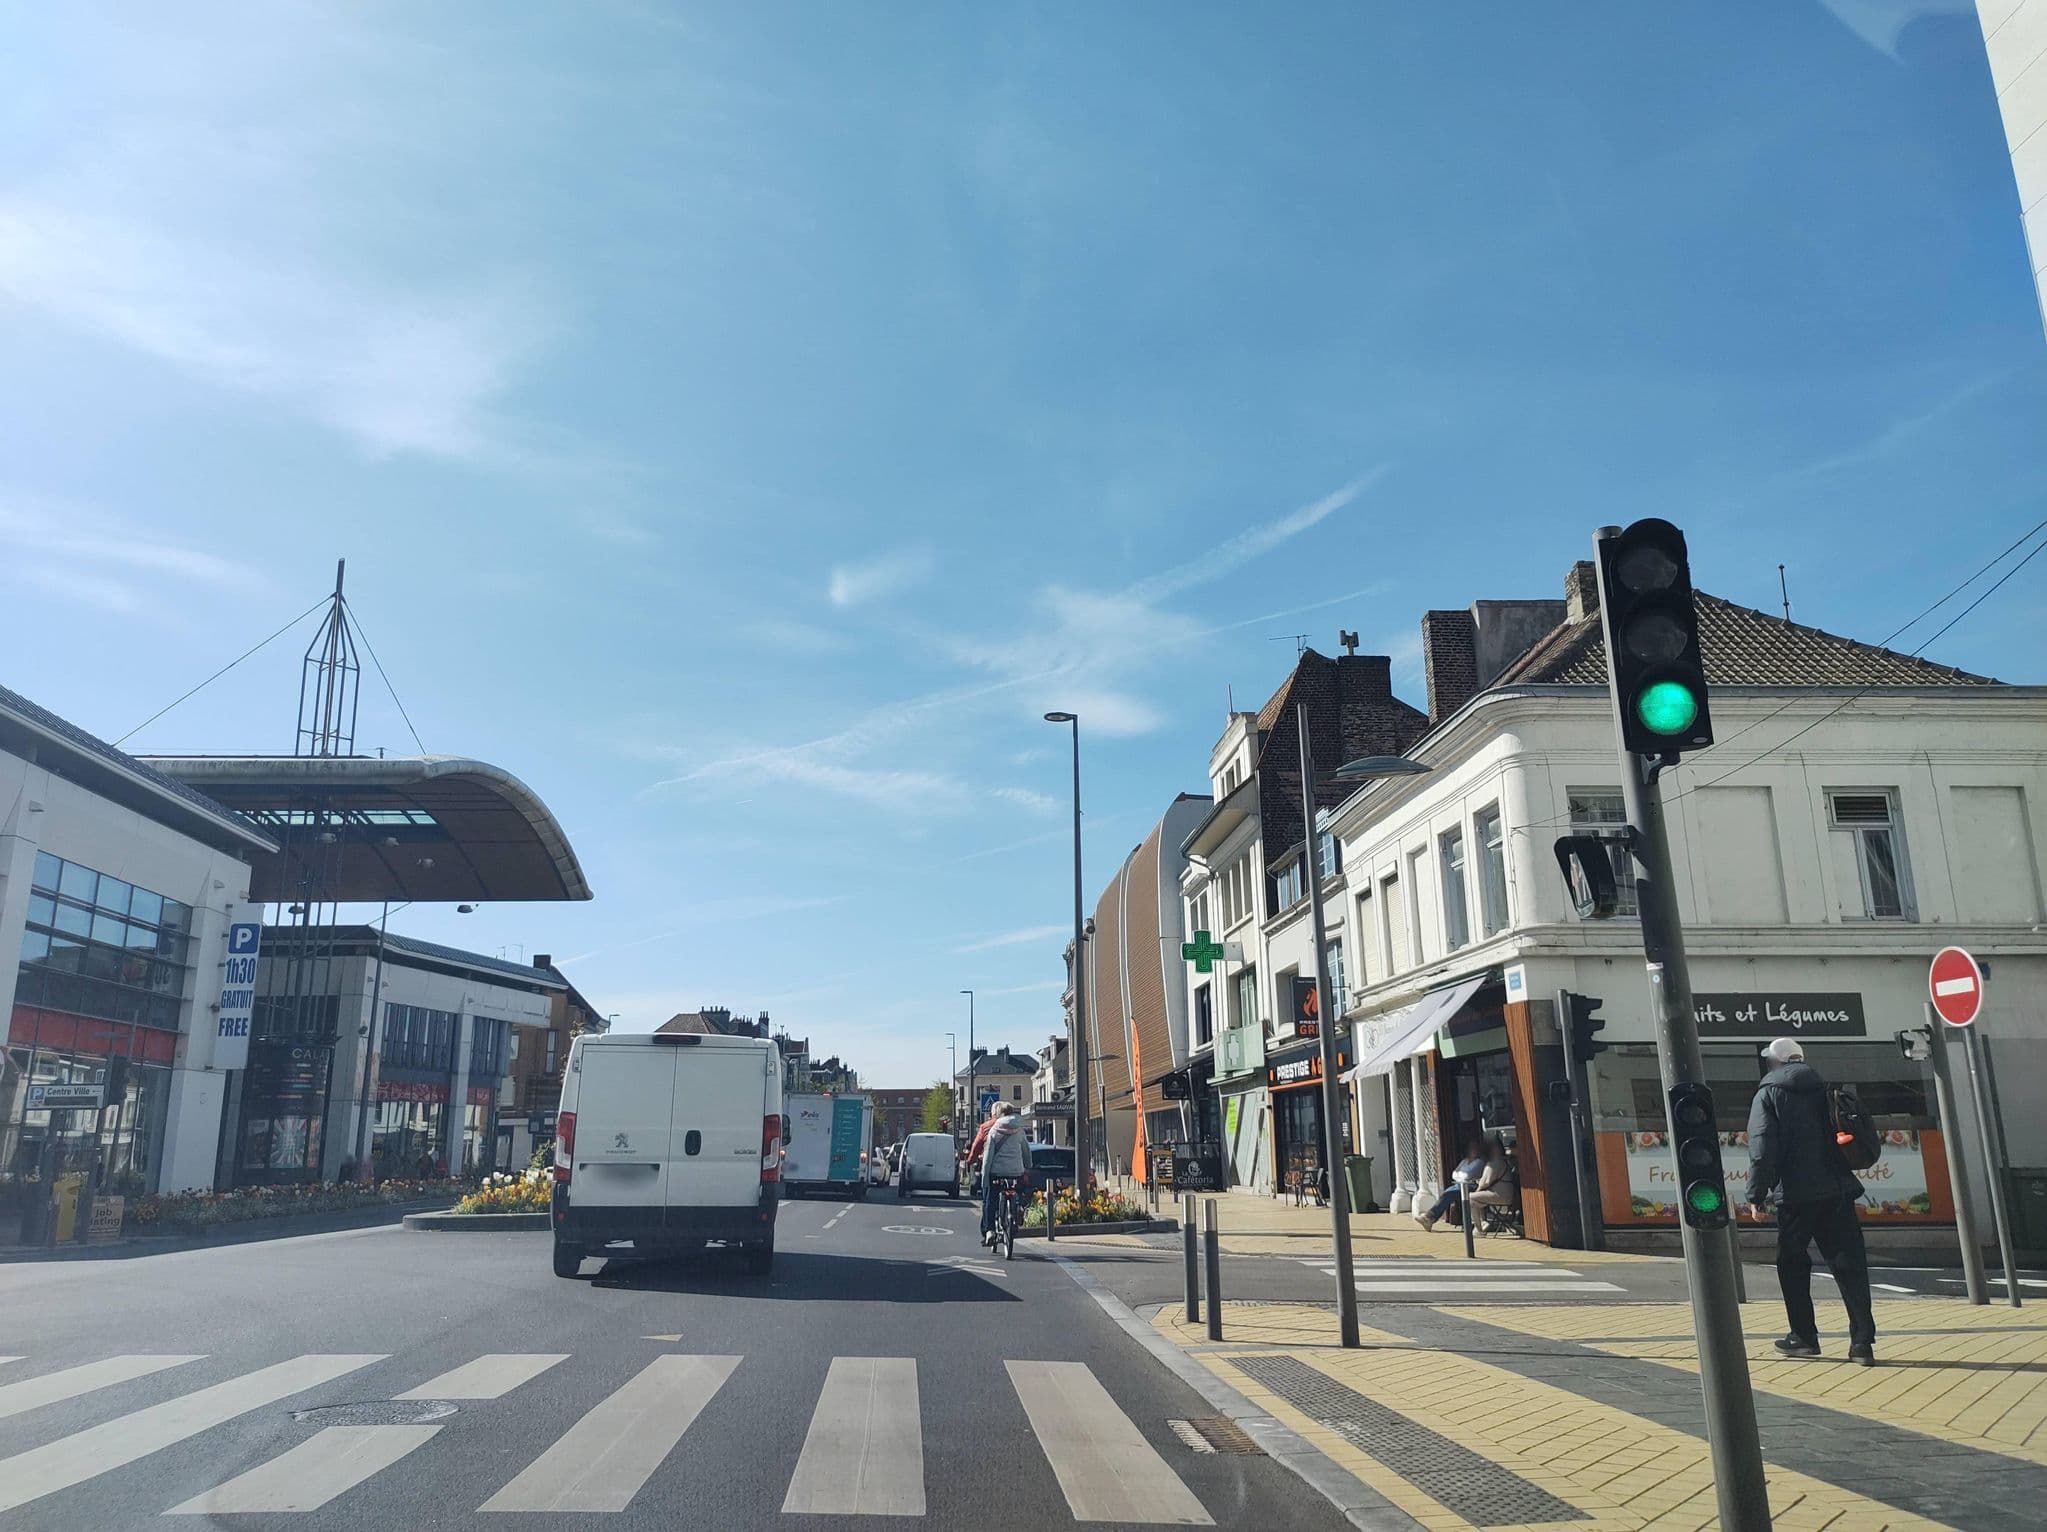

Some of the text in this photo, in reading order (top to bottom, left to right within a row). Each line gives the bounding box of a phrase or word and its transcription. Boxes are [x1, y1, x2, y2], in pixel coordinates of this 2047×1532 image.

[225, 957, 256, 984] 1h30
[221, 990, 254, 1009] GRATUIT
[1735, 1004, 1758, 1022] et
[1765, 1001, 1850, 1028] Légumes
[218, 1017, 249, 1037] FREE
[1276, 1060, 1310, 1081] PRESTIGE
[47, 1086, 90, 1096] Centre Ville
